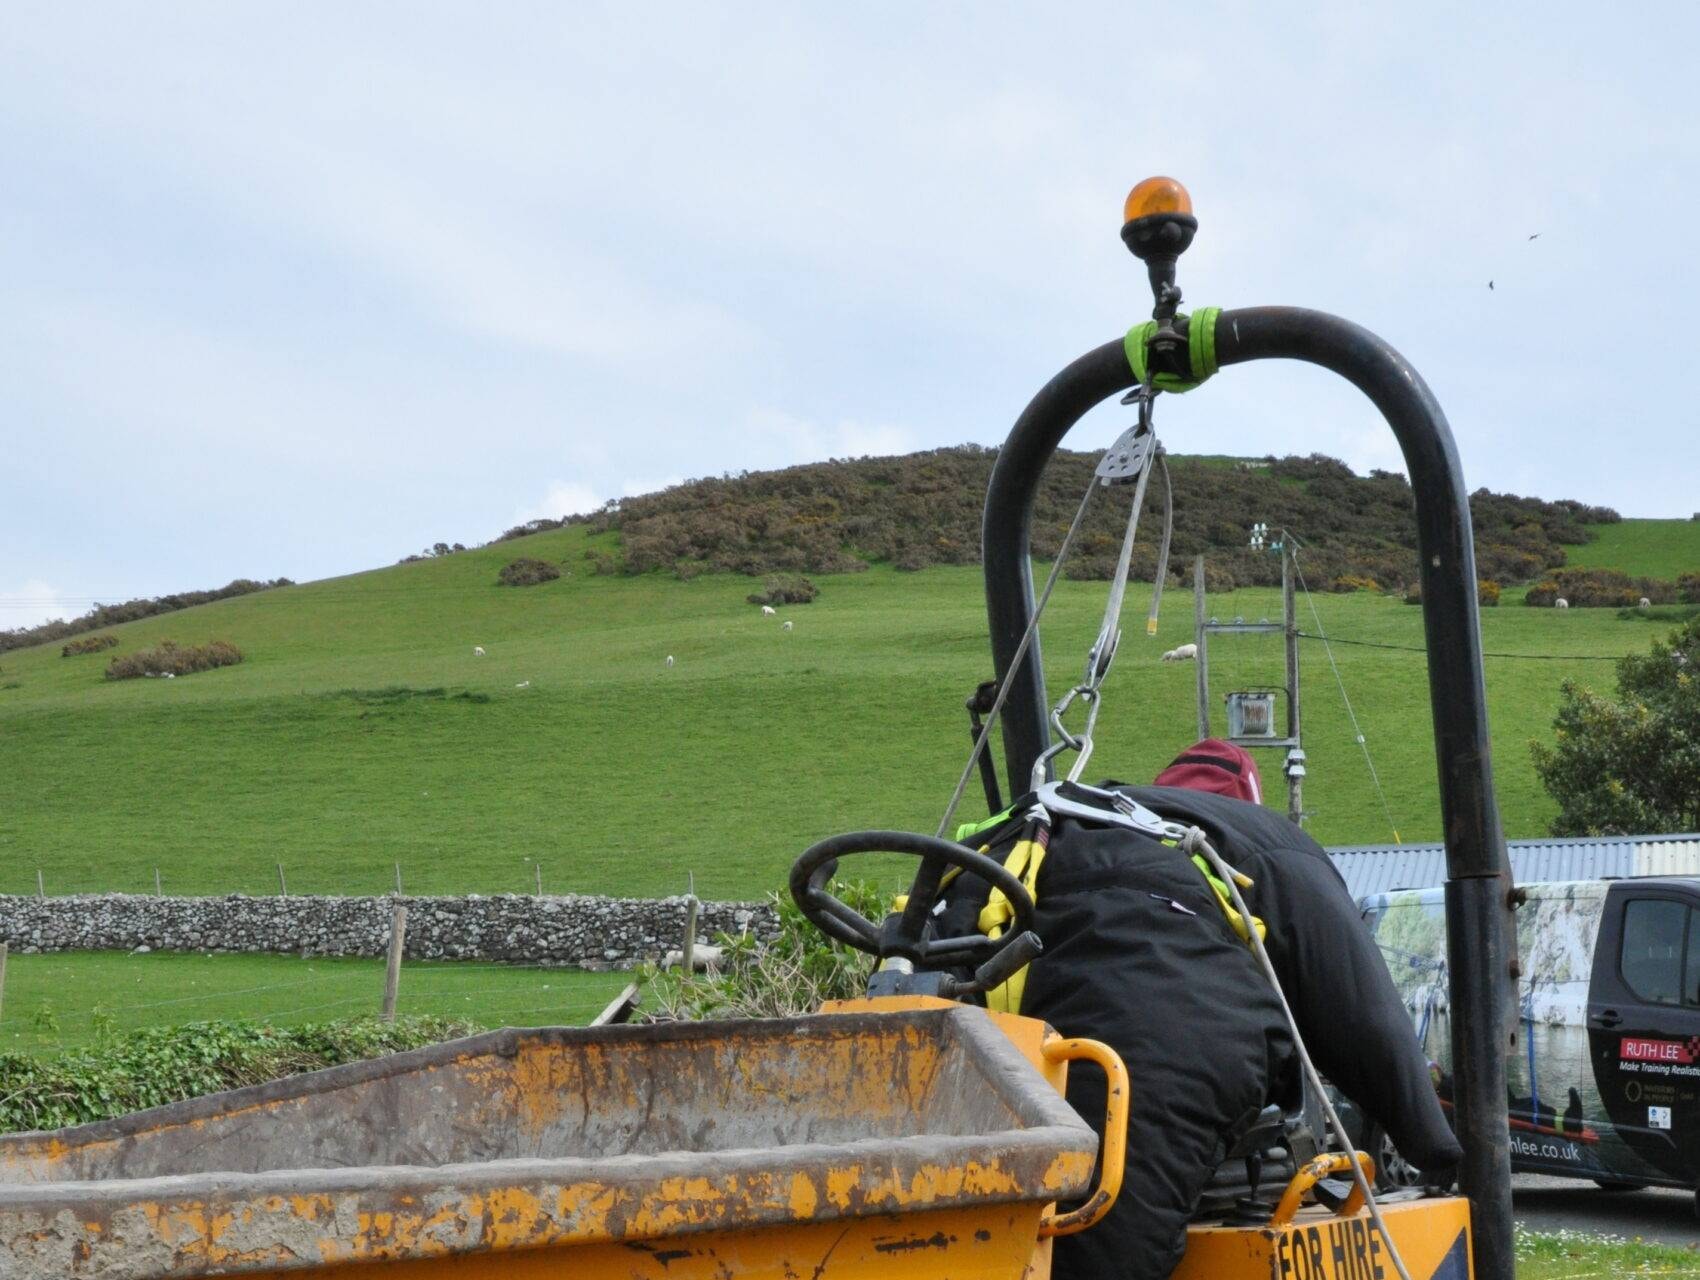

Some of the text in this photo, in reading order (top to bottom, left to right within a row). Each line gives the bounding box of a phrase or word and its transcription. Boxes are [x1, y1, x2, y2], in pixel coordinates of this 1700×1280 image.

[1626, 1042, 1679, 1060] RUTH LEE
[1619, 1061, 1640, 1072] Make
[1641, 1062, 1670, 1076] Training
